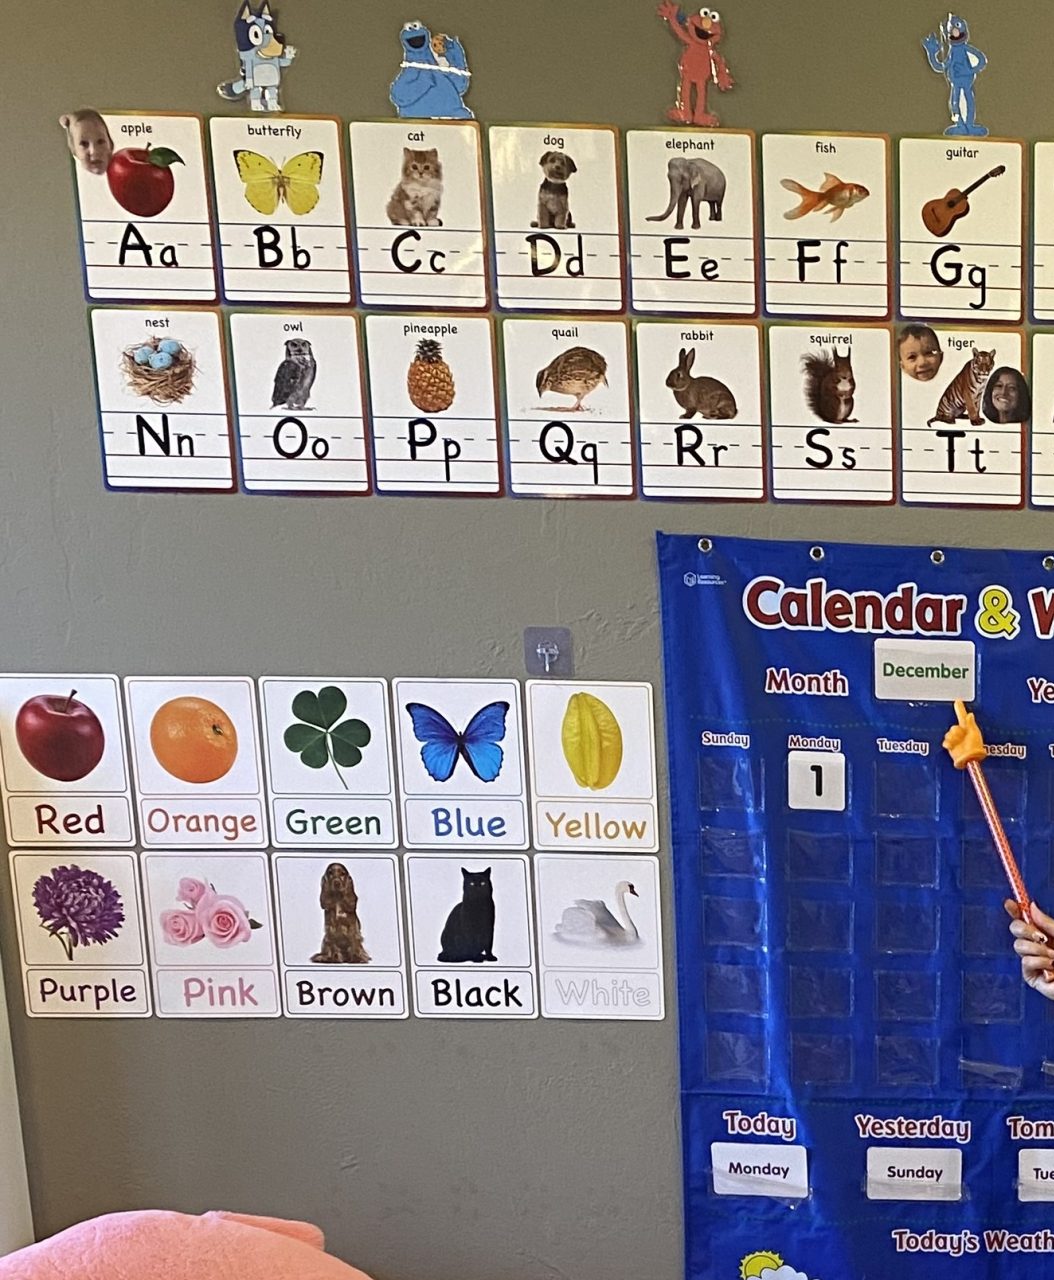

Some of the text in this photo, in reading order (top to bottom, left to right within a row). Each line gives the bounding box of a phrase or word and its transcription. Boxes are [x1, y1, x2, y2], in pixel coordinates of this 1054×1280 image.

[121, 123, 152, 136] apple
[248, 125, 301, 139] butterfly
[408, 131, 424, 141] cat
[544, 135, 564, 149] dog
[666, 138, 714, 152] elephant
[816, 142, 836, 153] fish
[946, 147, 979, 160] guitar
[118, 223, 178, 267] Aa
[253, 226, 311, 270] Bb
[392, 231, 445, 274] Cc
[526, 233, 584, 278] Dd
[663, 238, 719, 280] Ee
[797, 241, 849, 283] Ff
[930, 245, 986, 309] Gg
[146, 318, 169, 327] nest
[284, 322, 303, 331] owl
[404, 323, 457, 336] pineapple
[552, 327, 578, 340] quail
[681, 331, 713, 340] rabbit
[810, 334, 852, 347] squirrel
[948, 337, 974, 351] tiger
[136, 414, 194, 458] Nn
[273, 417, 328, 459] Oo
[408, 419, 460, 481] Pp
[675, 425, 728, 468] Rr
[806, 428, 856, 469] Ss
[540, 422, 599, 485] Qq
[935, 431, 987, 473] Tt
[741, 576, 967, 636] Calendar
[974, 586, 1020, 638] &
[765, 667, 849, 697] Month
[884, 663, 969, 679] December
[701, 731, 750, 749] Sunday
[788, 735, 841, 752] Monday
[877, 738, 929, 755] Tuesday
[982, 743, 1027, 760] nesday
[811, 765, 822, 796] 1
[35, 804, 104, 834] Red
[148, 808, 257, 844] Orange
[286, 809, 380, 835] Green
[432, 808, 506, 837] Blue
[546, 812, 646, 839] Yellow
[40, 978, 136, 1010] Purple
[184, 977, 258, 1007] Pink
[296, 981, 394, 1006] Brown
[431, 979, 522, 1007] Black
[555, 978, 651, 1007] White
[723, 1110, 796, 1140] Today
[854, 1114, 971, 1142] Yesterday
[729, 1162, 789, 1179] Monday
[888, 1166, 943, 1182] Sunday
[892, 1229, 979, 1257] Today's
